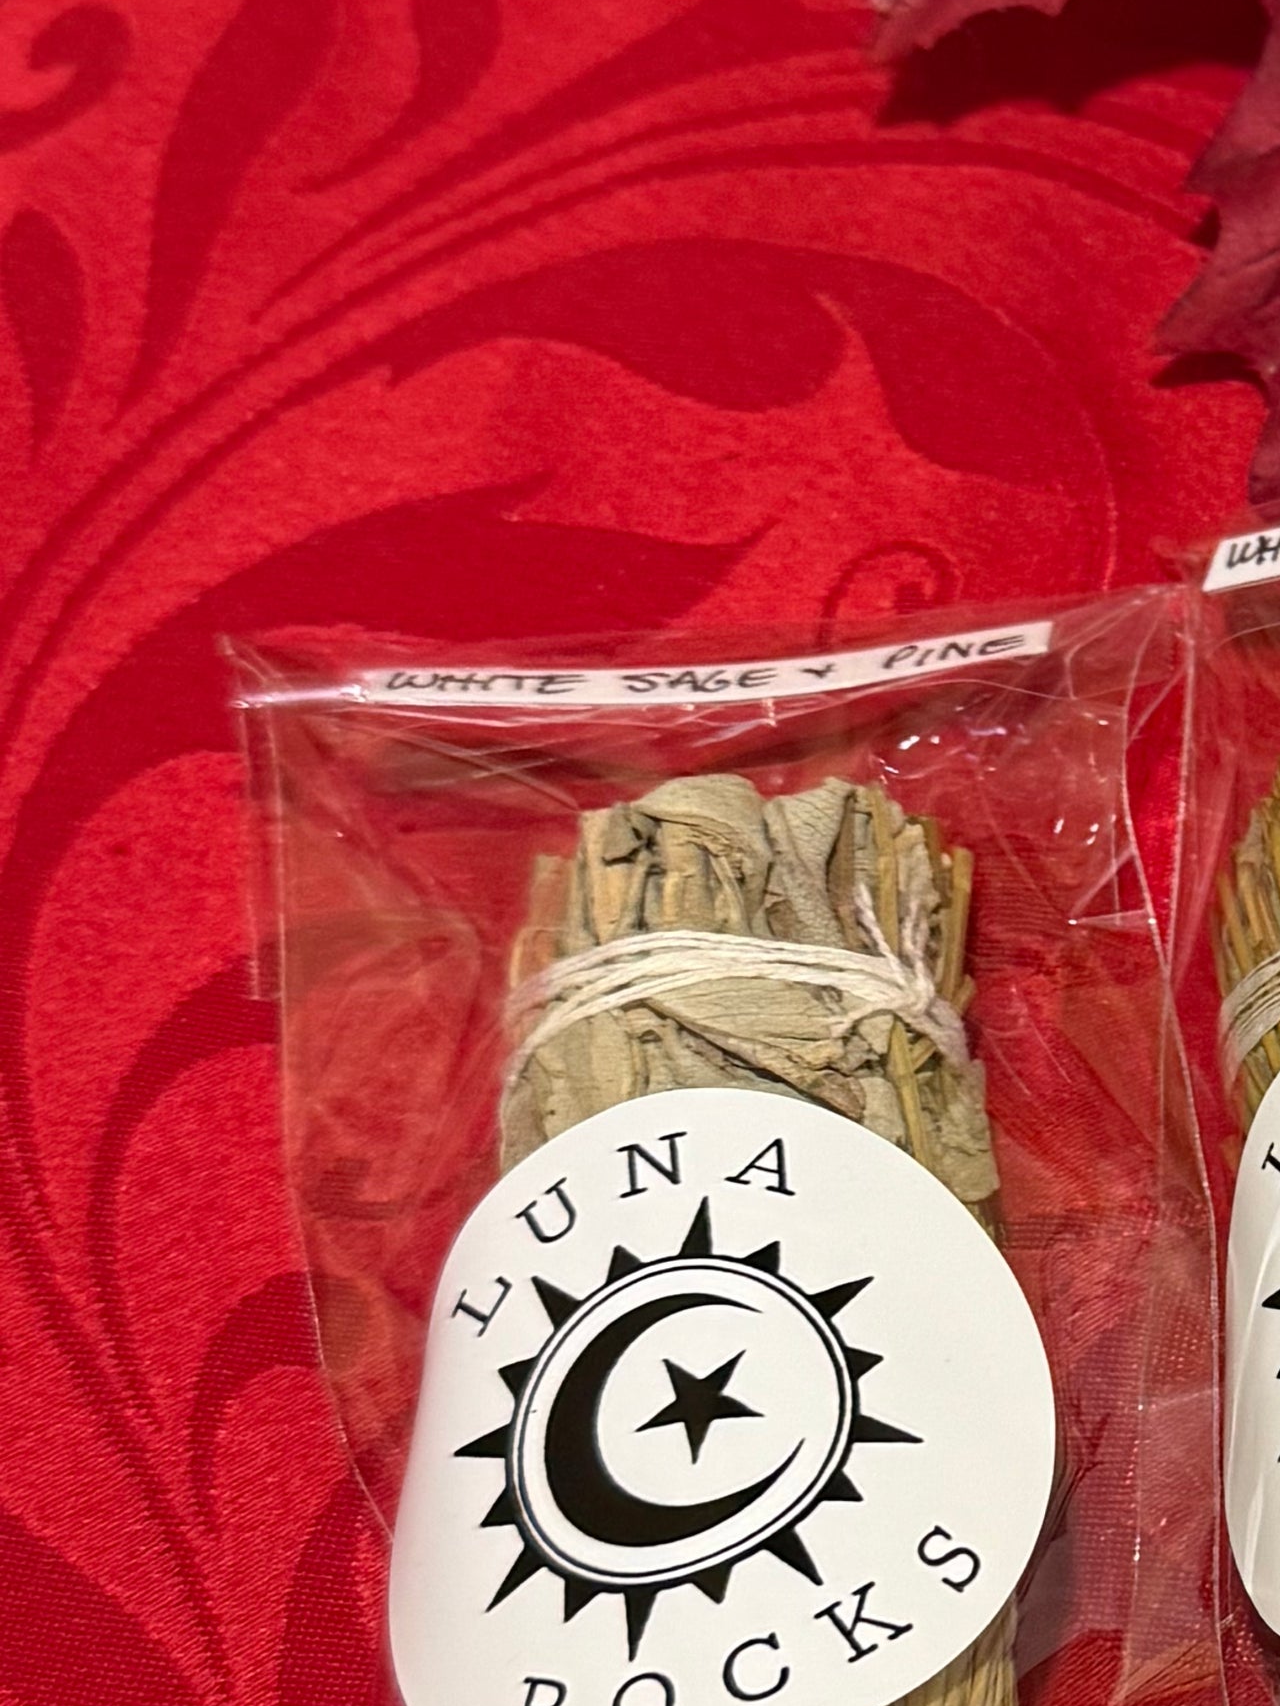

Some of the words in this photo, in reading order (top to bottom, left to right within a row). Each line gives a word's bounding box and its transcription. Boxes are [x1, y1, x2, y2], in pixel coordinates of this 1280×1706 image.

[386, 671, 588, 694] WHITE
[620, 667, 779, 692] SAGE
[883, 633, 1026, 670] PINE
[451, 1131, 796, 1337] LUNA
